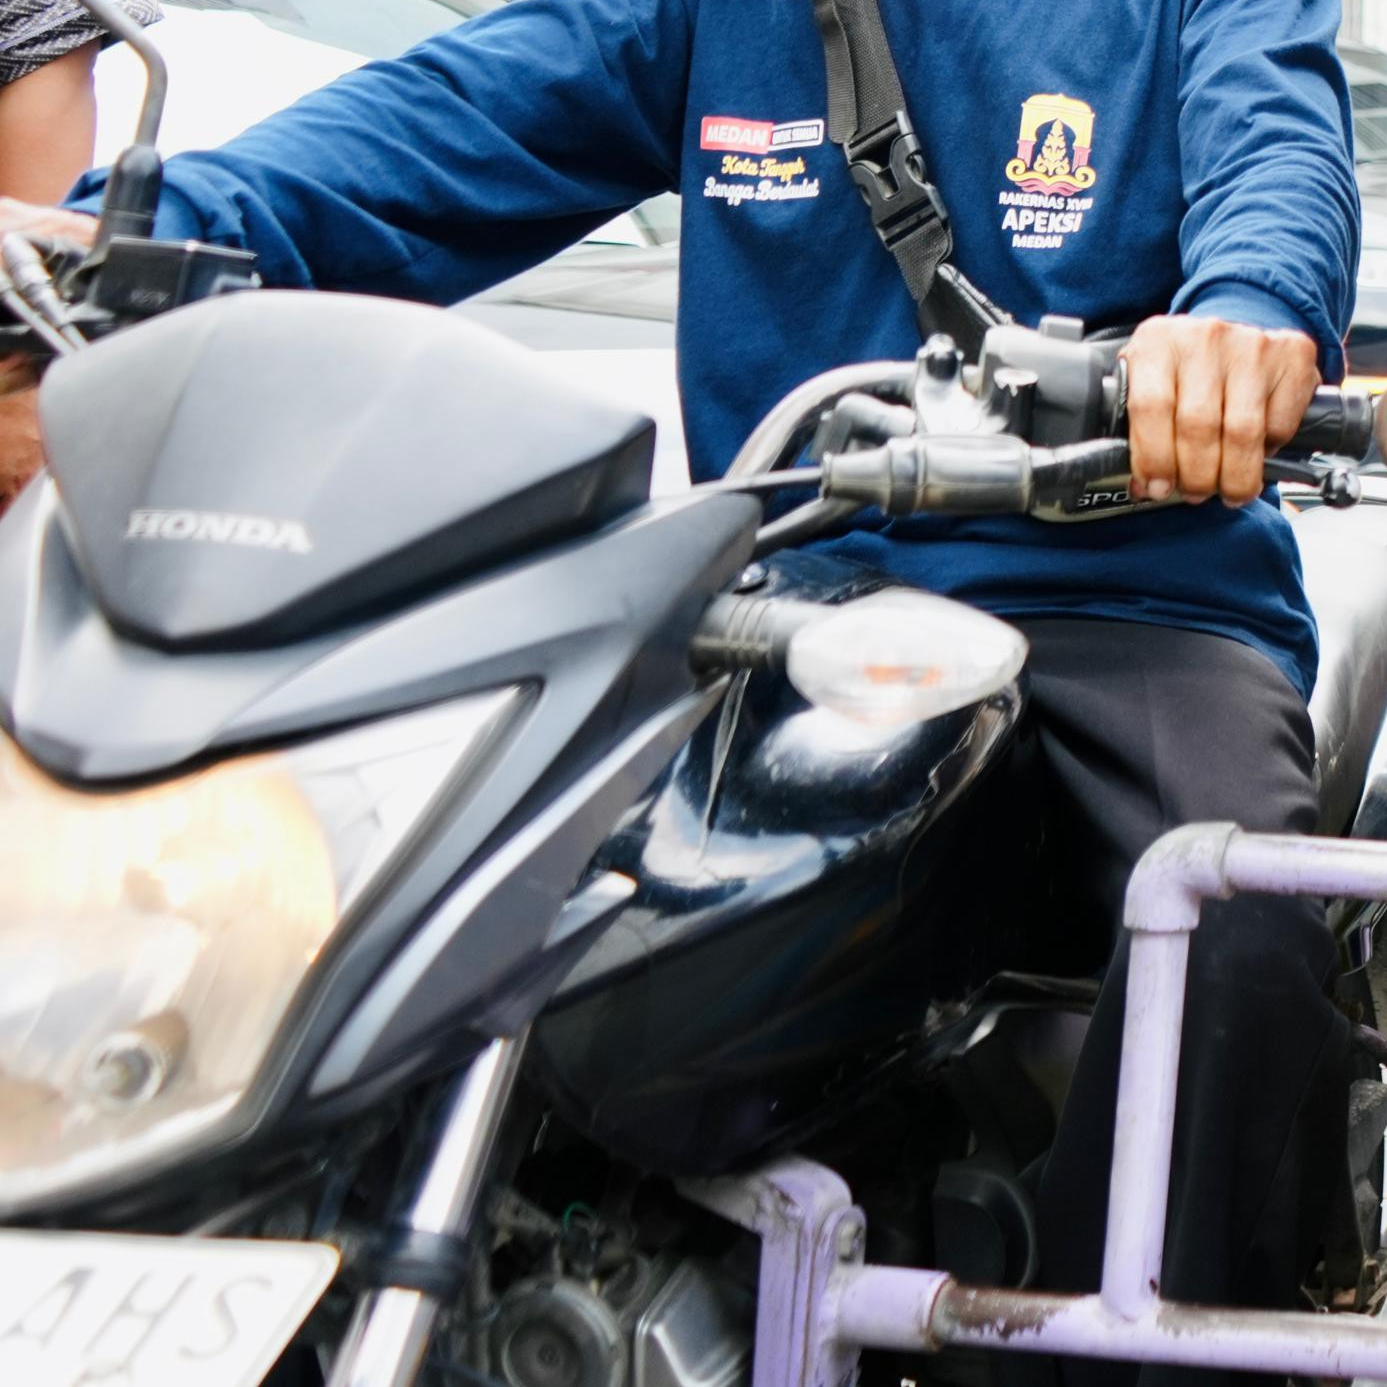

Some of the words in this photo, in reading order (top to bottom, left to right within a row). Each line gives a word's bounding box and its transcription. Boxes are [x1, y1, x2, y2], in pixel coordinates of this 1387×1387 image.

[705, 124, 768, 146] MEDAN
[721, 155, 759, 175] Kota
[998, 191, 1065, 209] RAKERNAS
[1001, 208, 1083, 233] APEKSI
[1012, 234, 1063, 248] MEDAN
[124, 509, 315, 554] HONDA
